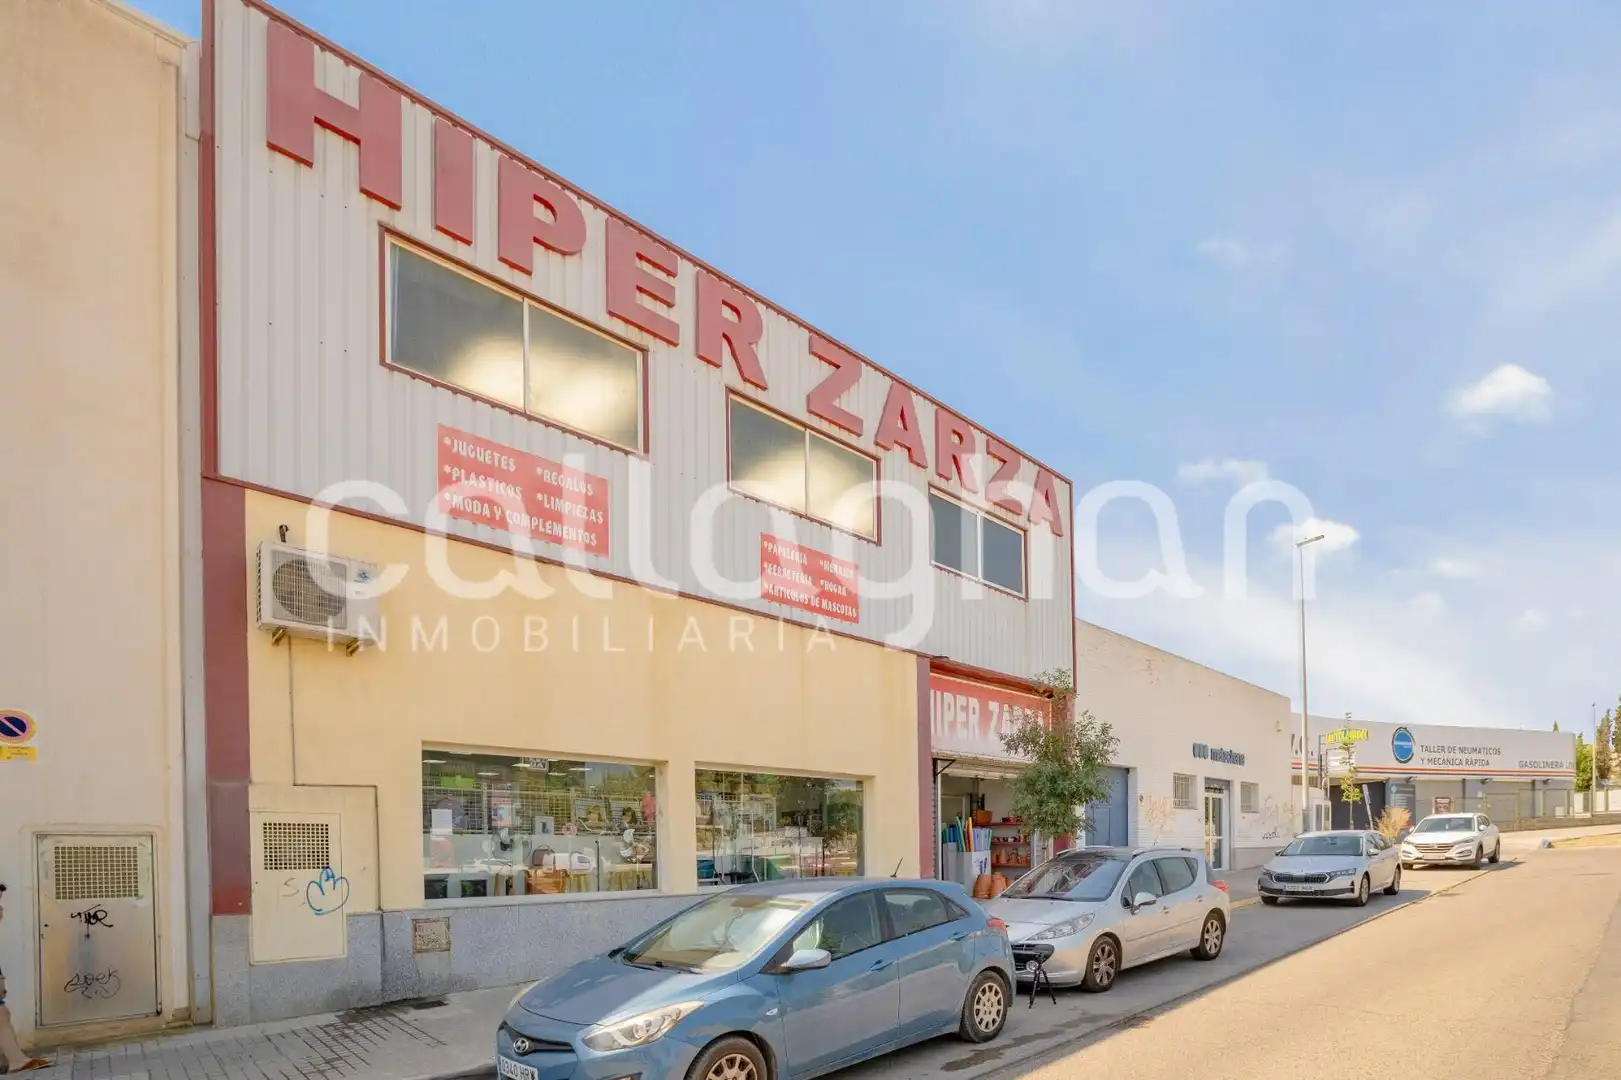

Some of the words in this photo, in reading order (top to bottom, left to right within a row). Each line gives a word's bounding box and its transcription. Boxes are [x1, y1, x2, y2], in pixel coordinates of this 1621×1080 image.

[267, 17, 768, 391] HIPER
[807, 333, 1064, 538] ZARZA
[451, 438, 517, 473] JUGUETES
[451, 466, 523, 501] PLASTICOS
[543, 469, 594, 497] REGALOS
[451, 492, 491, 518] MODA
[494, 506, 502, 521] Y
[505, 509, 598, 547] COMPLEMENTOS
[543, 495, 604, 525] LIMPIEZAS
[811, 595, 820, 608] DE
[821, 599, 857, 618] MASCOTAS
[1420, 745, 1446, 754] TALLER
[1447, 746, 1457, 754] DE
[1420, 757, 1426, 765] Y
[1518, 759, 1563, 769] GASOLINERA
